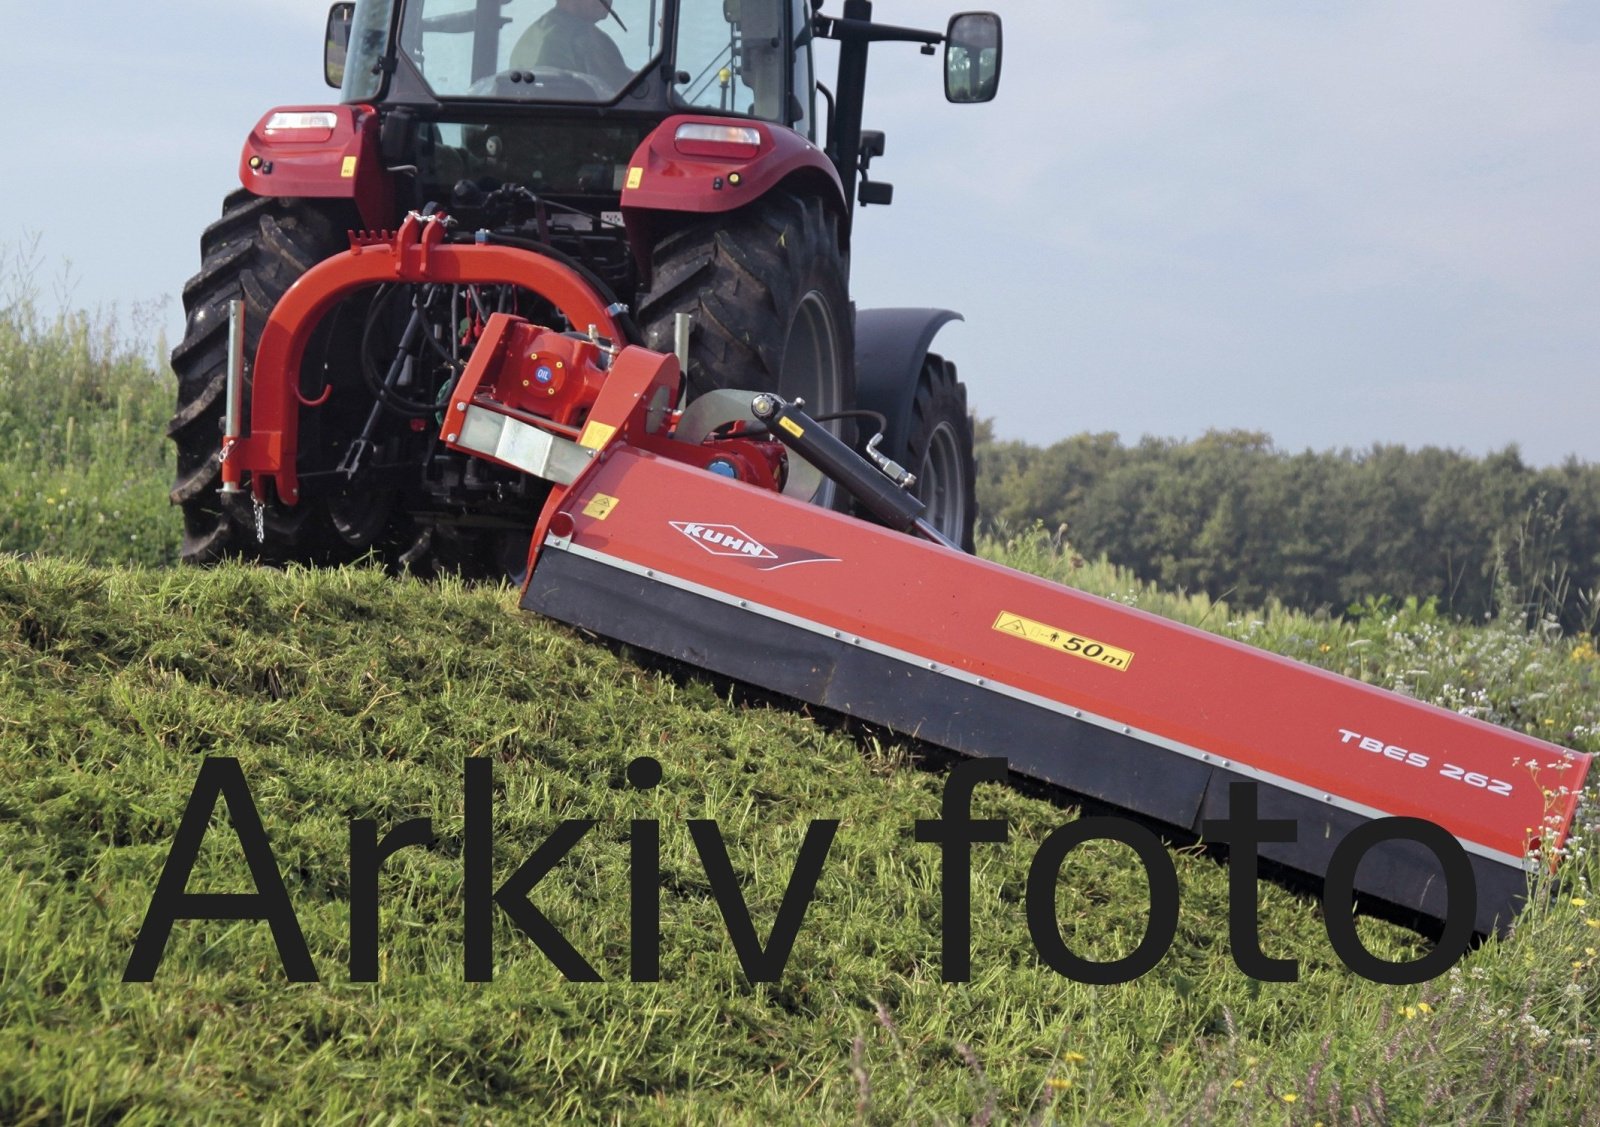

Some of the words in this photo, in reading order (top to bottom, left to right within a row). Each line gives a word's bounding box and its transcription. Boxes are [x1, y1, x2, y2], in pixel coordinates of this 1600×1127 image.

[683, 522, 764, 557] KUHN
[1338, 728, 1430, 768] TBES
[1439, 763, 1513, 797] 262
